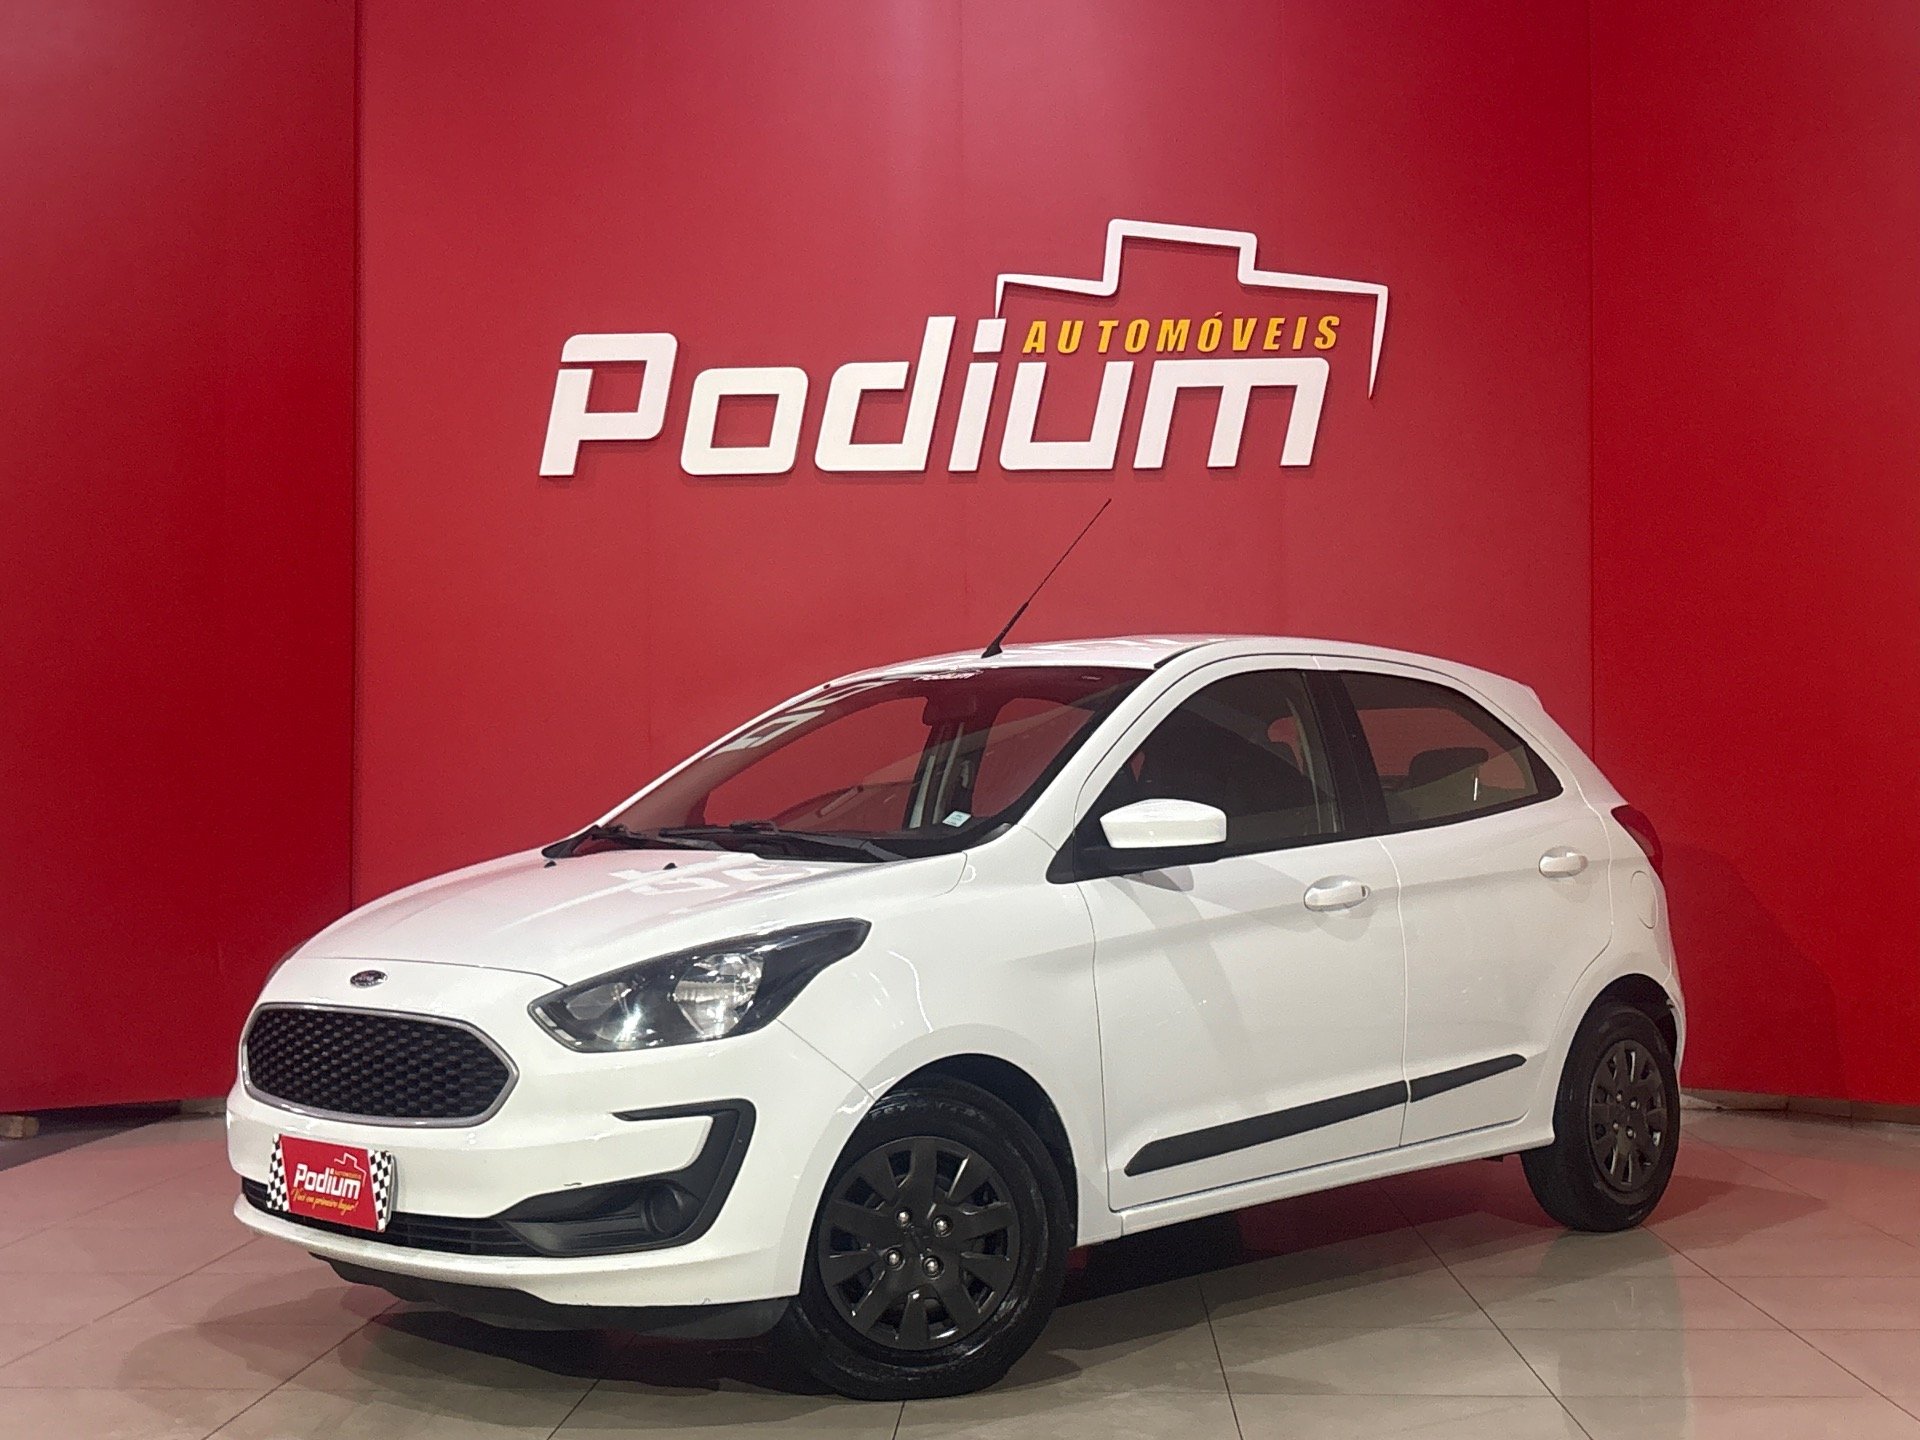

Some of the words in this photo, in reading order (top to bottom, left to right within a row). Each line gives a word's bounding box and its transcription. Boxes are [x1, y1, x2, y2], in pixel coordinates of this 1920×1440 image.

[1022, 312, 1342, 354] AUTOMÓVEIS
[539, 316, 1330, 476] Podium
[293, 1163, 361, 1200] Podium
